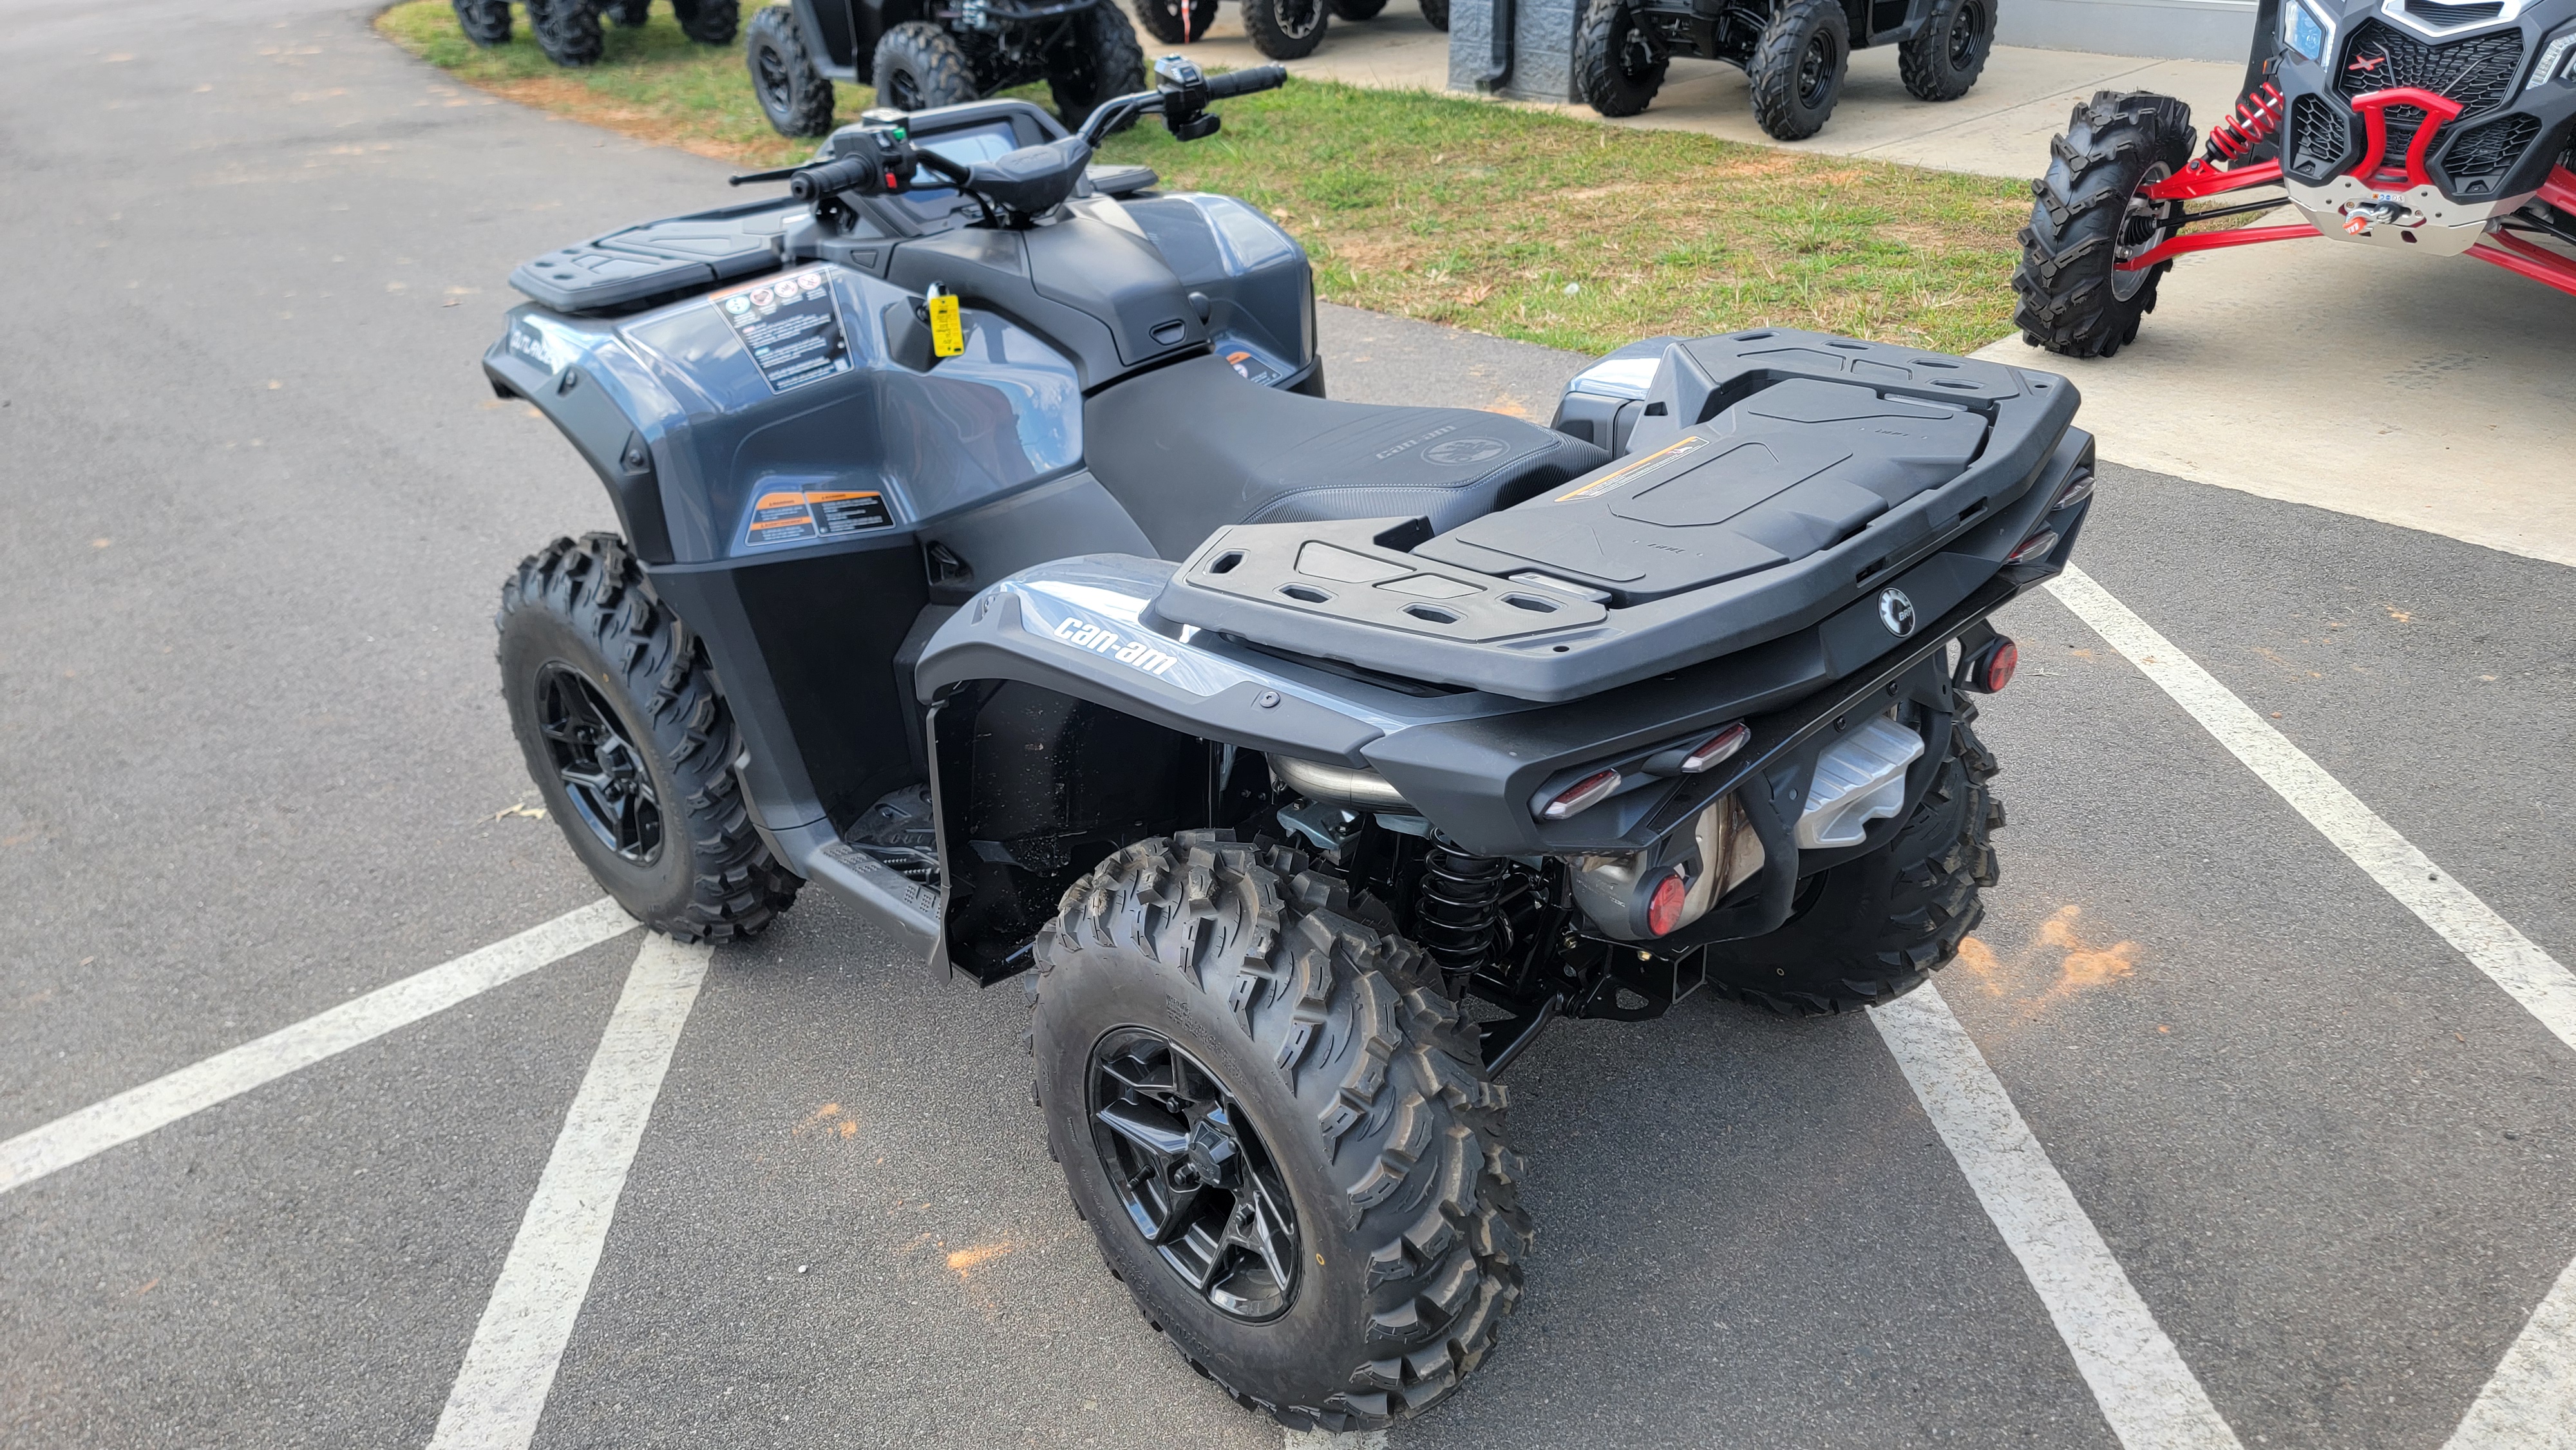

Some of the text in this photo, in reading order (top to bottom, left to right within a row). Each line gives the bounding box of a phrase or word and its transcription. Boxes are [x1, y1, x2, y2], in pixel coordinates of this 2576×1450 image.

[1376, 425, 1457, 459] can-am
[1899, 607, 1913, 621] BRP
[1054, 616, 1178, 675] can-am
